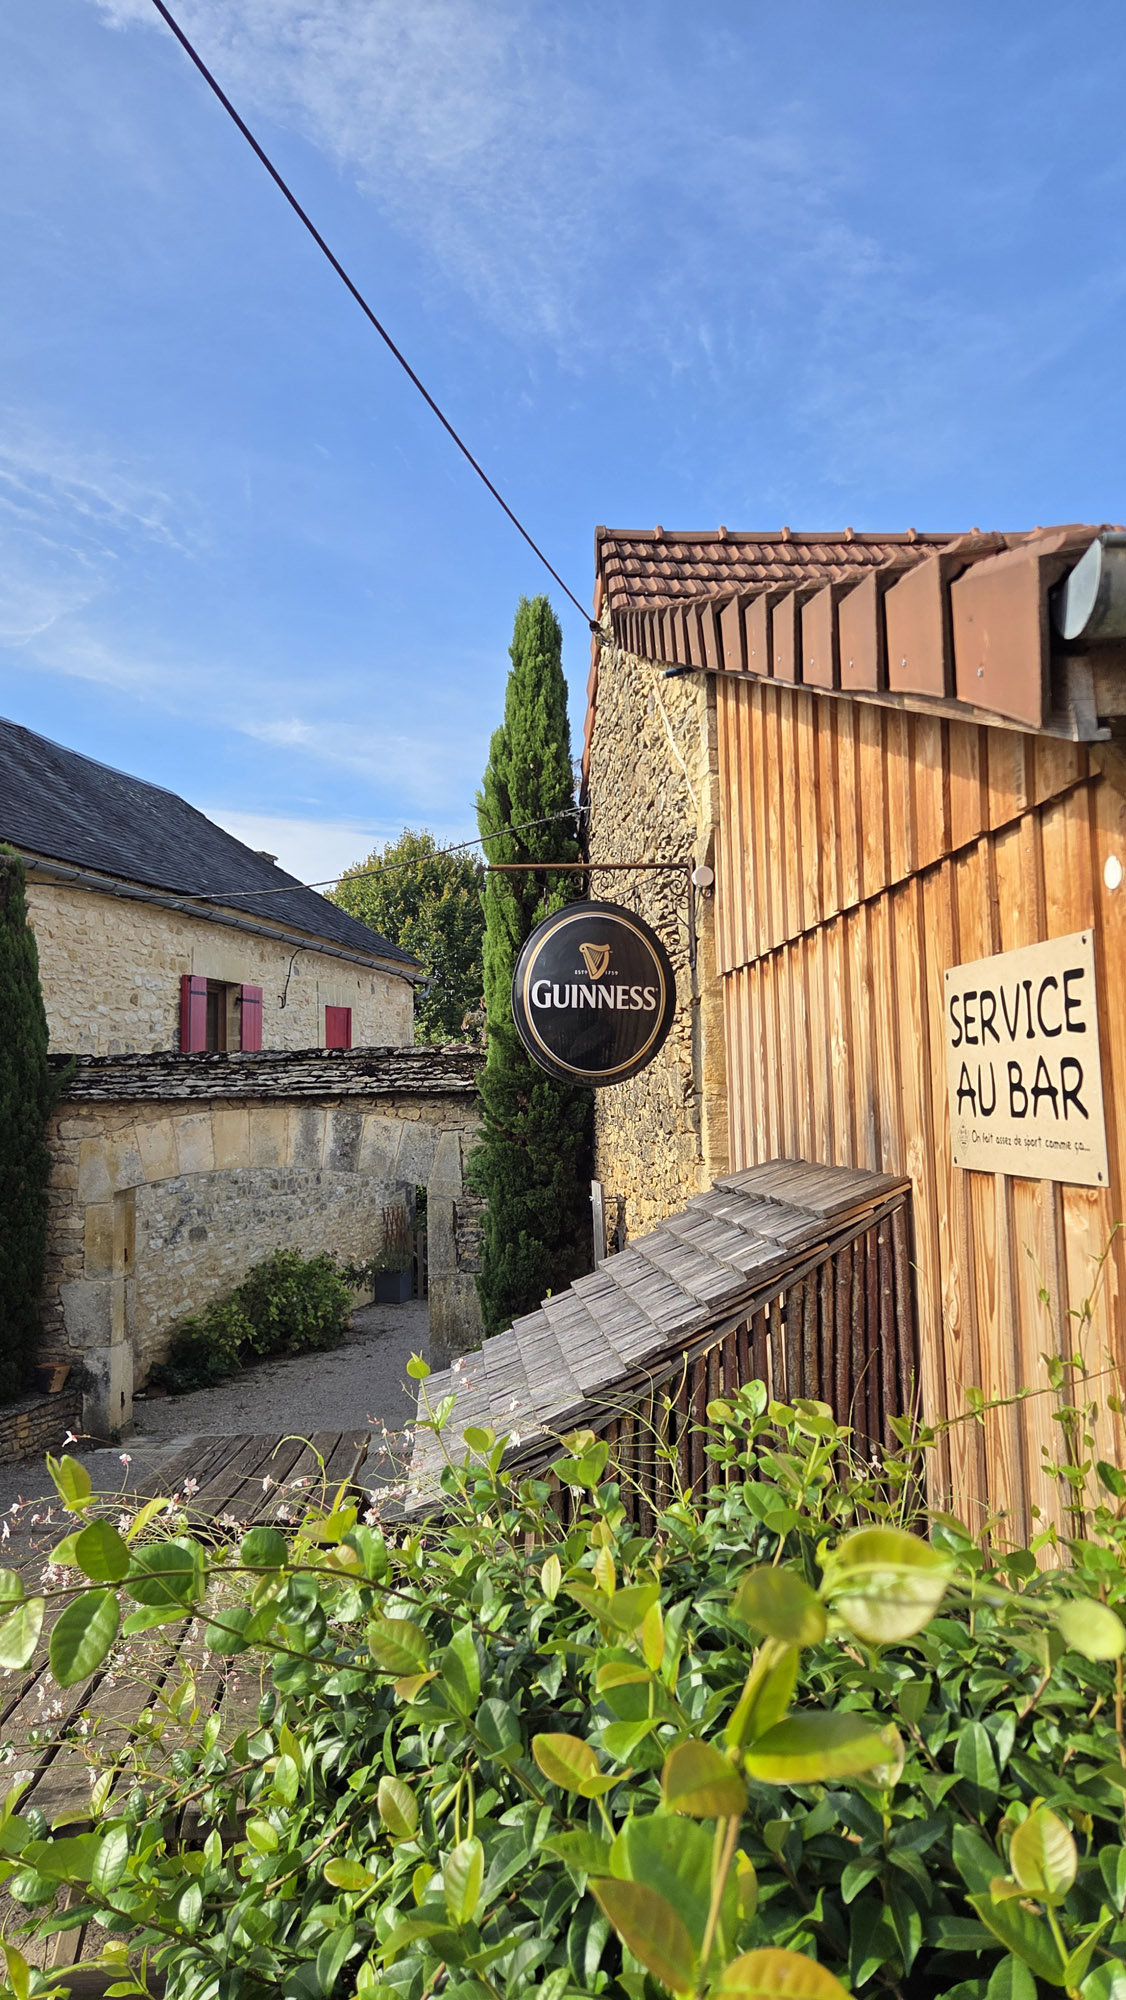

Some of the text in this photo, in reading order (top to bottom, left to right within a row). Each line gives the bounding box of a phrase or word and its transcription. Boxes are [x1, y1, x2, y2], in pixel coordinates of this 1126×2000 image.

[531, 980, 657, 1010] GUINNESS
[950, 968, 1086, 1048] SERVICE
[957, 1055, 1088, 1120] AU BAR
[972, 1129, 981, 1143] On
[982, 1132, 993, 1144] fait
[996, 1136, 1011, 1146] assez
[1014, 1134, 1021, 1146] de
[1024, 1134, 1042, 1151] sport
[1045, 1139, 1071, 1150] comme
